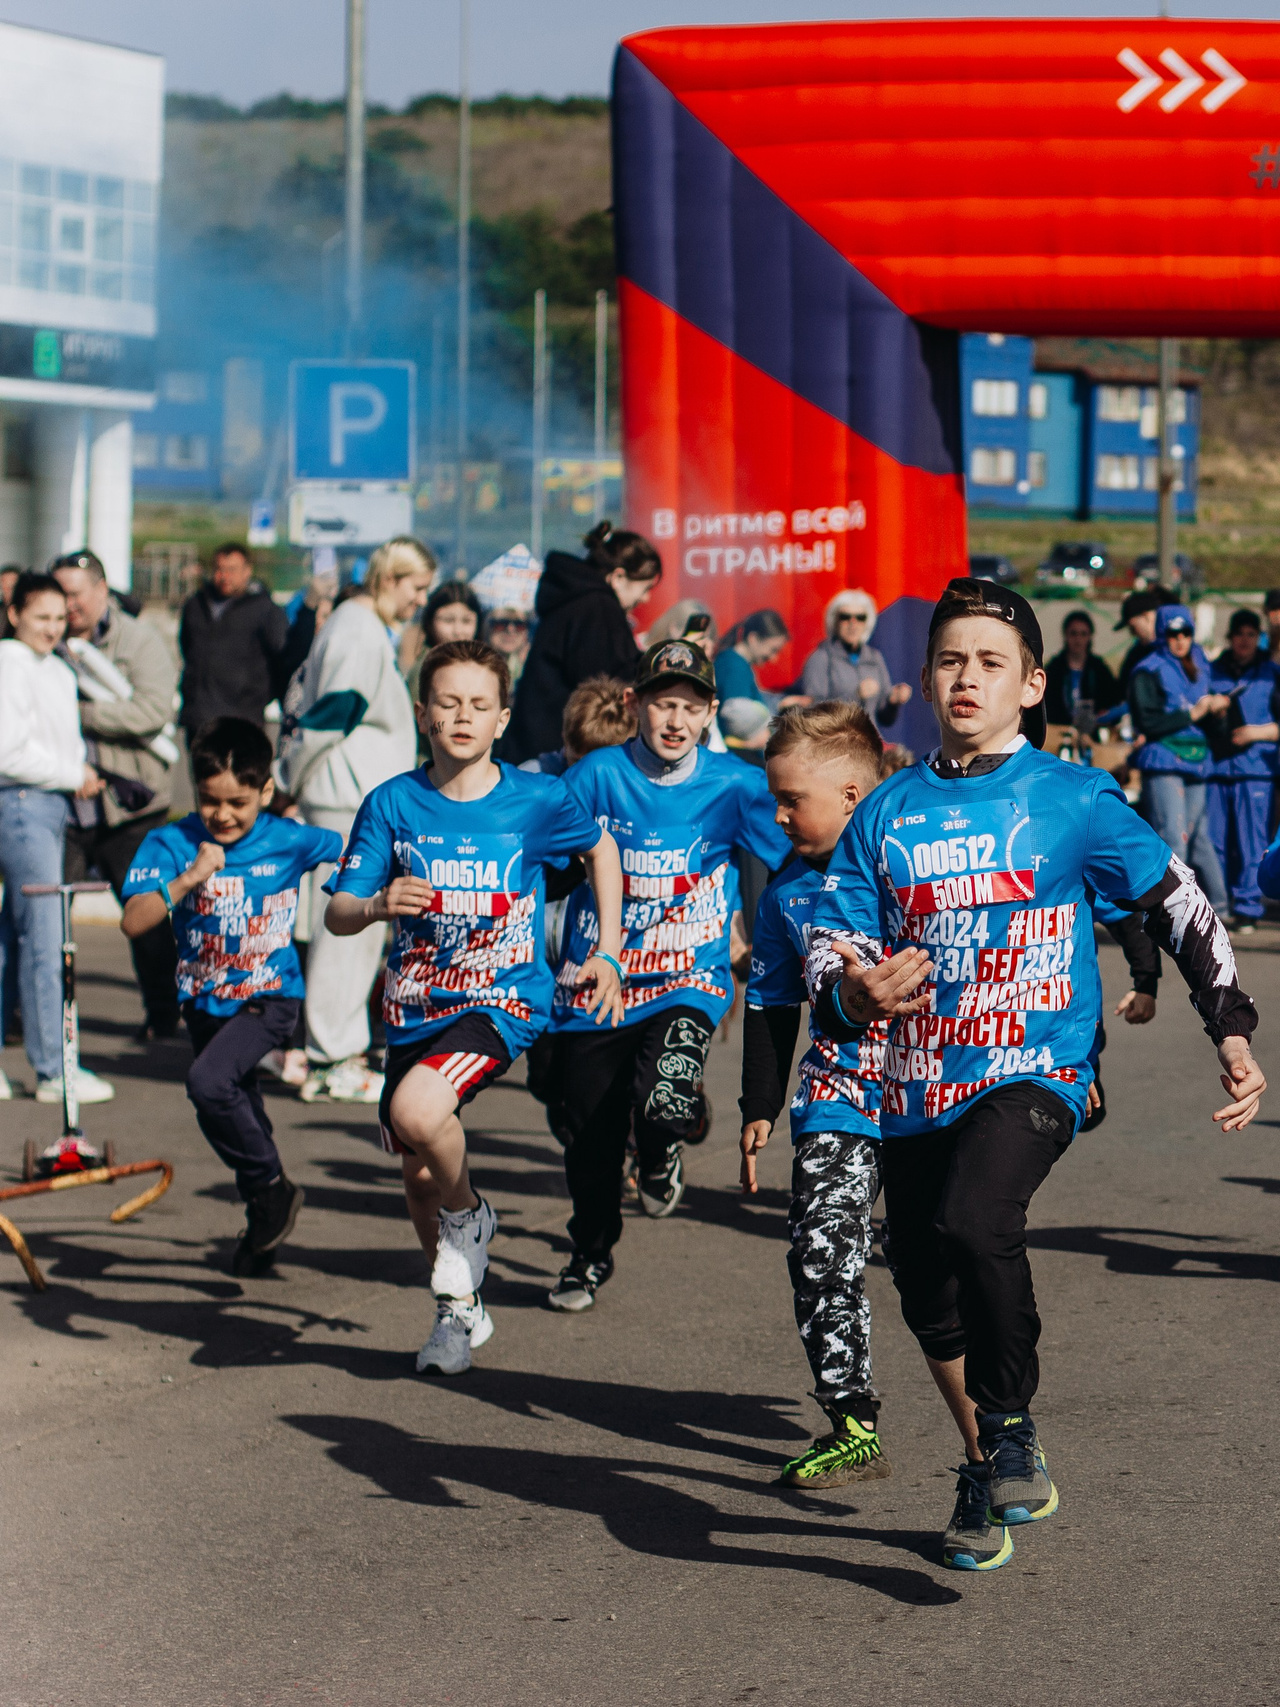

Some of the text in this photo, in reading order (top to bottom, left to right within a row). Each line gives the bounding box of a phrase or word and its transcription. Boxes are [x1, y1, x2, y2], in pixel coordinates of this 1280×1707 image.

[329, 382, 388, 467] P
[653, 500, 866, 540] В ритме всей
[685, 541, 835, 577] СТРАНЫ!
[431, 859, 500, 889] 00514
[624, 848, 686, 876] 00525
[913, 834, 997, 878] 00512
[956, 974, 1073, 1017] #МОМЕНТ
[984, 1047, 1054, 1078] 2024
